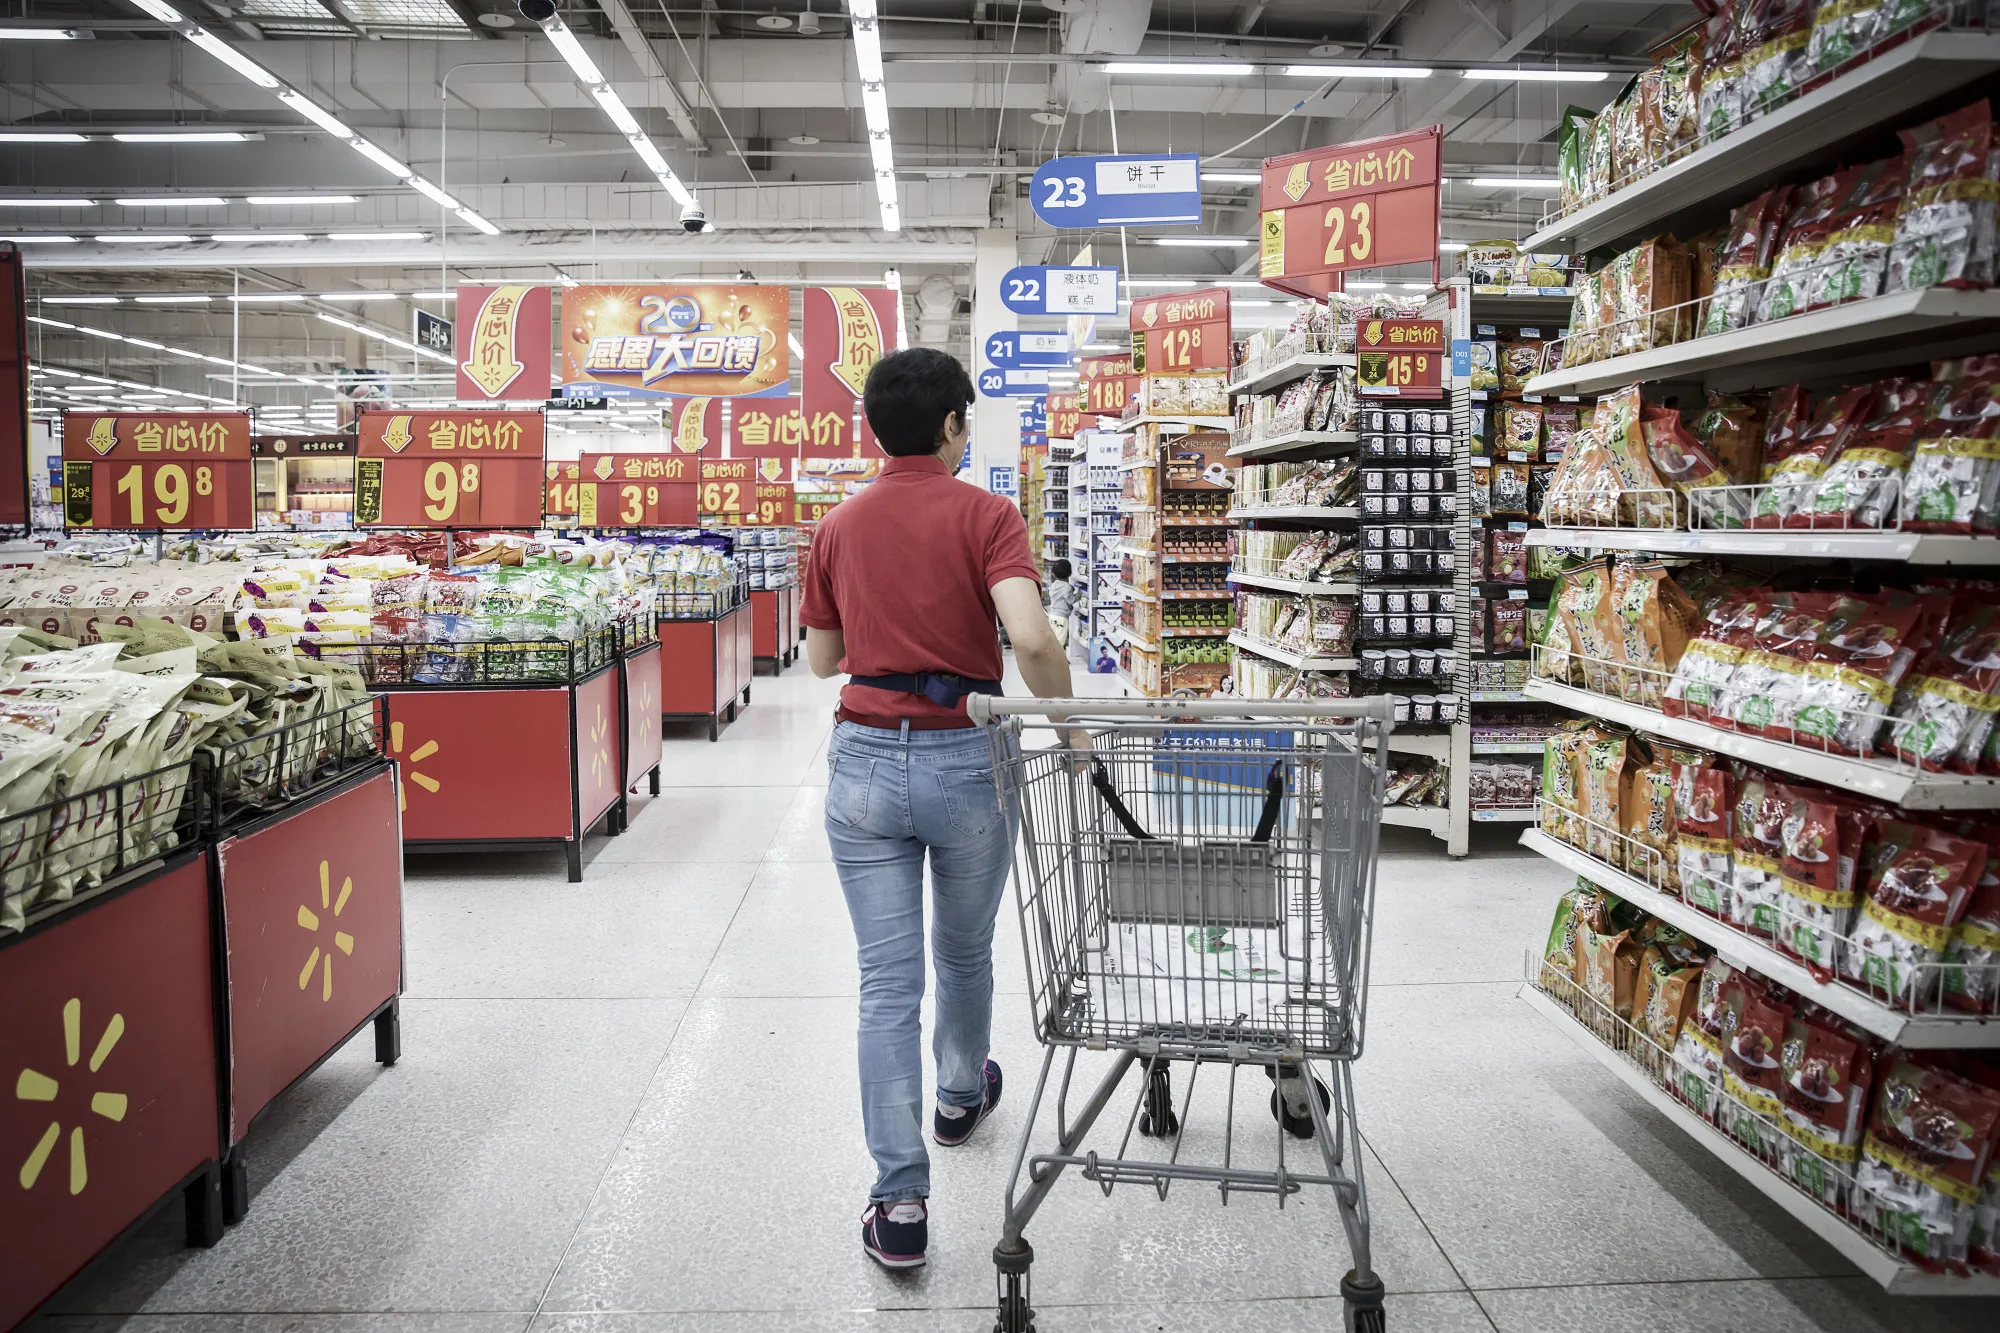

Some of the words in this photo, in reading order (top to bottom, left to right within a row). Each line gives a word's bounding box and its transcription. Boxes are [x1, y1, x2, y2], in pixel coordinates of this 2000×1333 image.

[1127, 166, 1164, 182] 饼干
[1324, 148, 1415, 192] 省心价
[1043, 177, 1087, 208] 23
[1324, 202, 1371, 265] 23
[1008, 279, 1040, 301] 22
[1064, 273, 1098, 285] 液体奶
[1165, 298, 1215, 323] 省心价
[481, 297, 513, 366] 省心价
[843, 301, 874, 366] 省心价
[1389, 326, 1438, 344] 省心价
[585, 334, 758, 380] 感恩大回馈
[990, 340, 1012, 357] 21
[982, 376, 1003, 389] 20
[133, 421, 229, 453] 省心价
[428, 418, 523, 451] 省心价
[737, 409, 846, 447] 省心价
[623, 457, 685, 478] 省心价
[702, 462, 746, 478] 省心价
